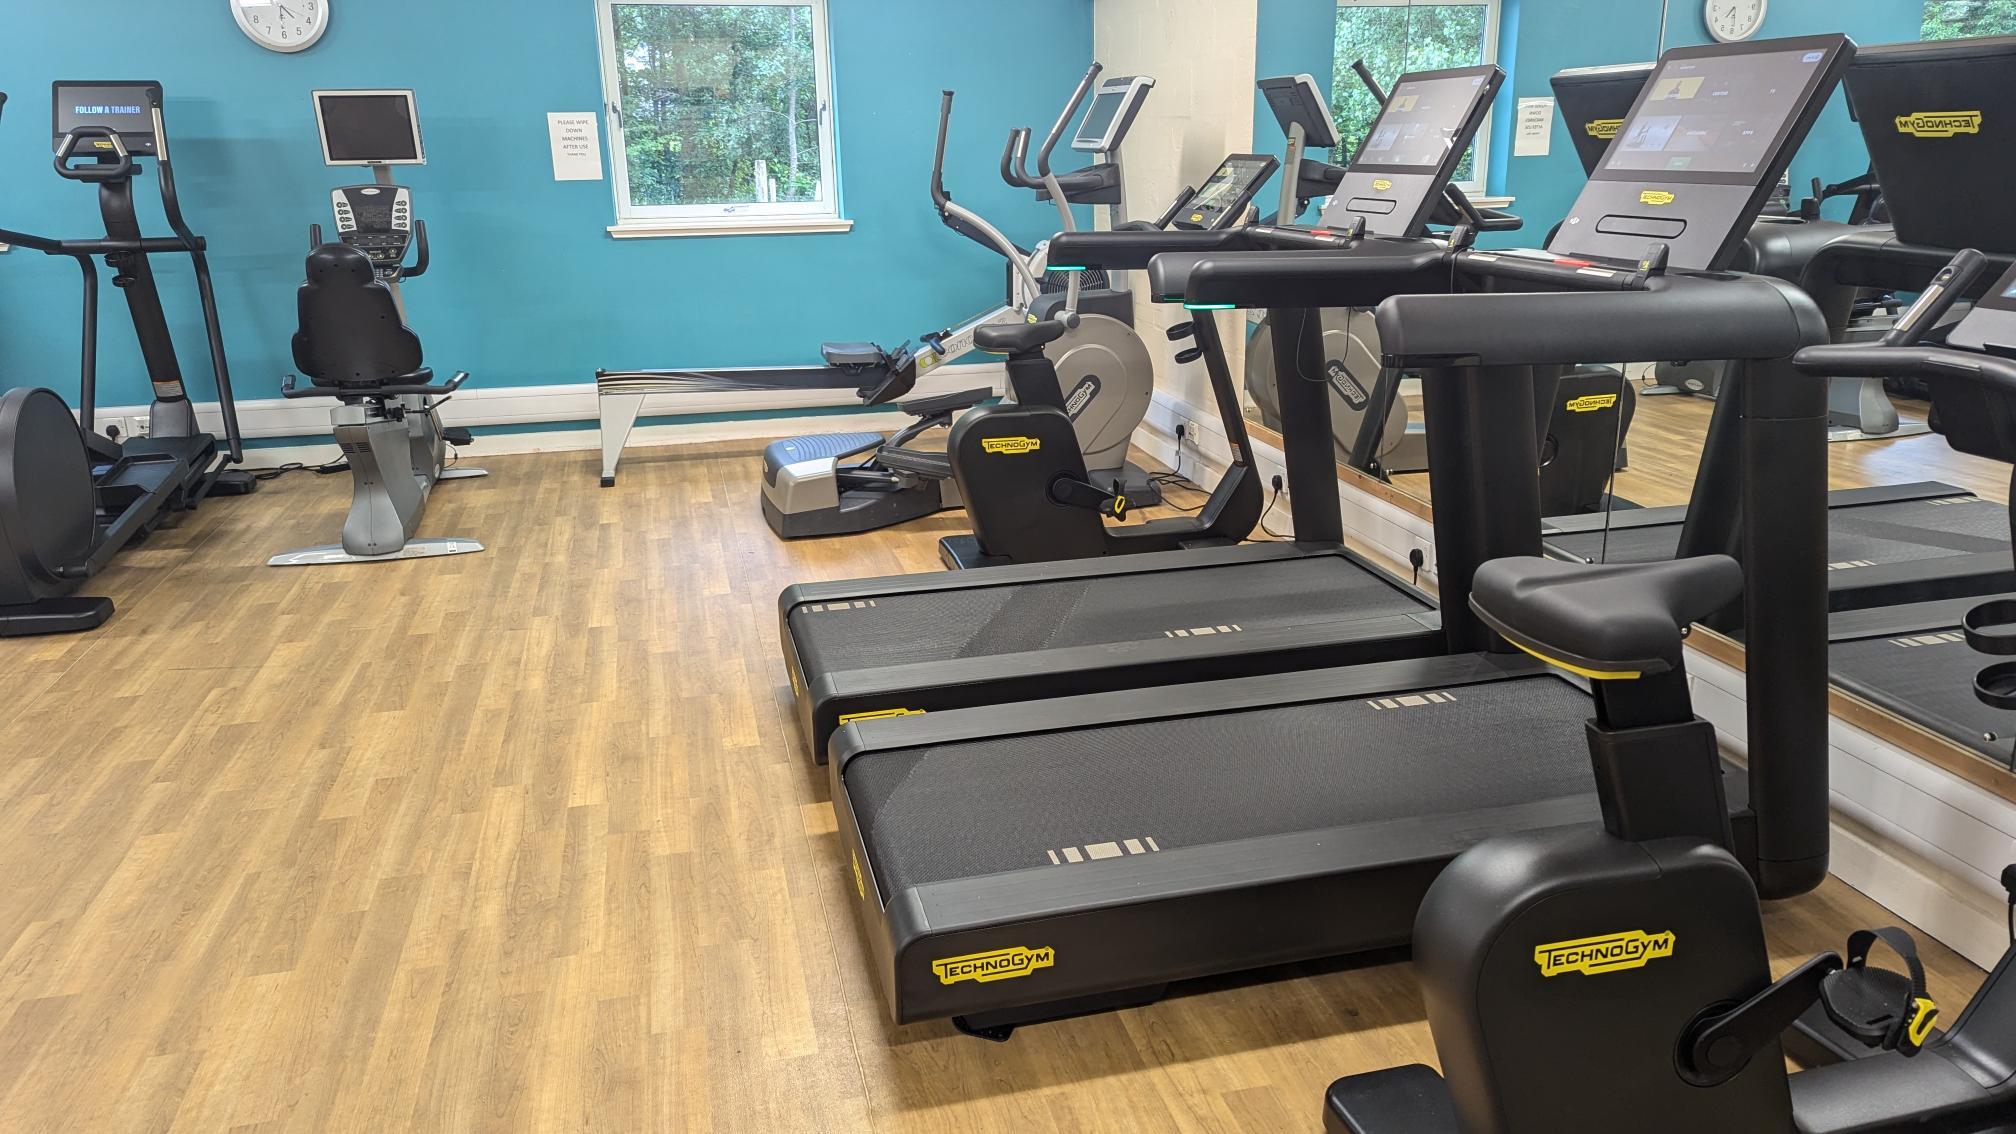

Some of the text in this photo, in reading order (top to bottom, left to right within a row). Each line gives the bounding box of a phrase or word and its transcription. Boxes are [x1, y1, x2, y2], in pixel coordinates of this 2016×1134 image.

[308, 2, 314, 11] 3
[253, 15, 259, 24] 8
[306, 16, 312, 25] 4
[266, 26, 271, 34] 7
[296, 27, 302, 35] 5
[281, 31, 287, 39] 6
[75, 105, 141, 114] FOLLOW A TRAINER
[984, 439, 1038, 451] TECHNOGYM
[1538, 937, 1669, 970] TECHNOGYM
[935, 952, 1050, 979] TECHNOGYM
